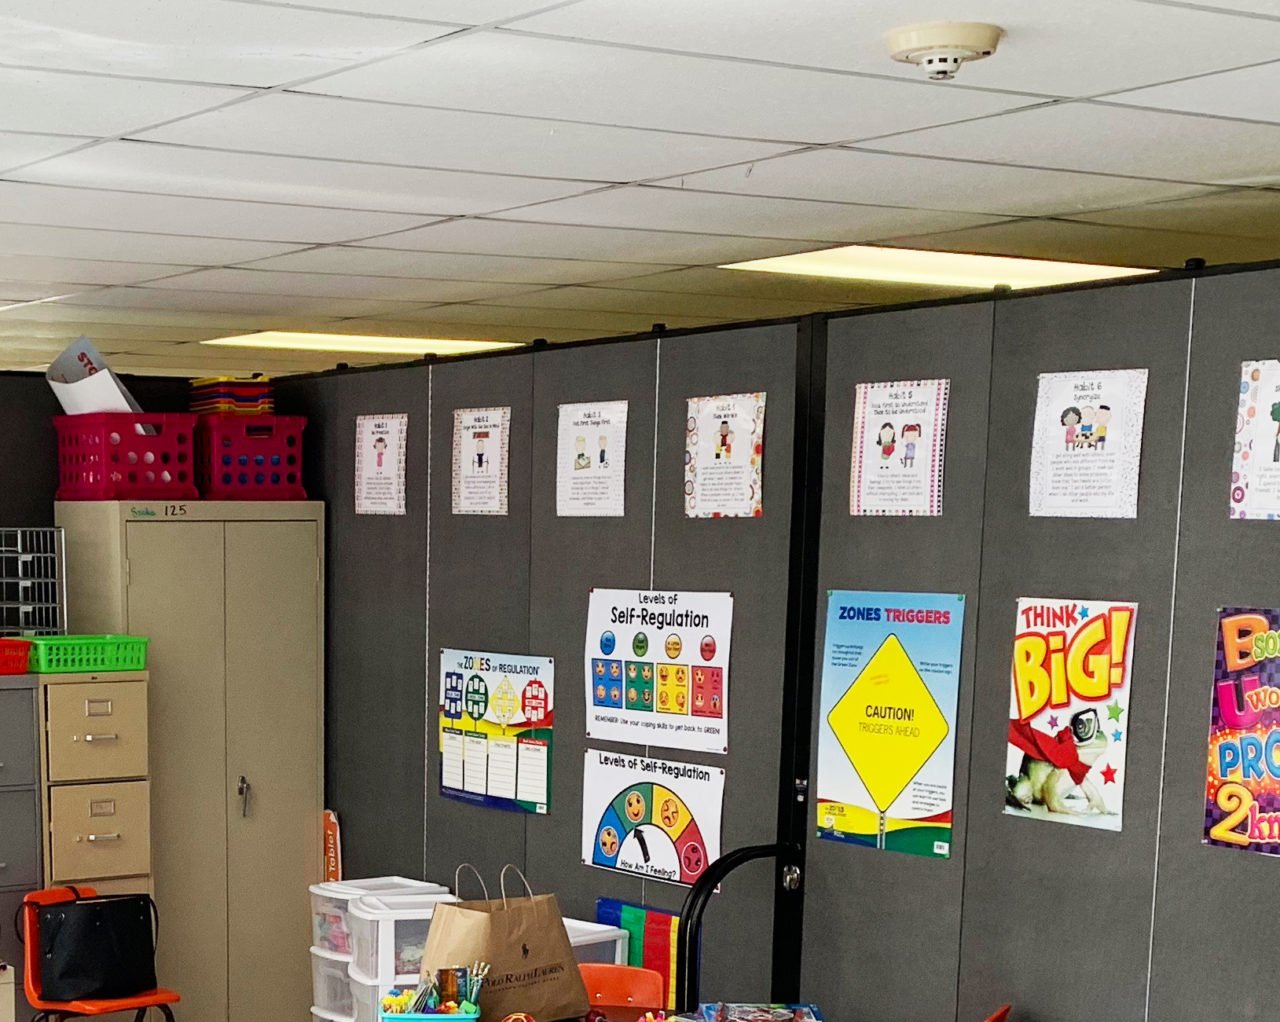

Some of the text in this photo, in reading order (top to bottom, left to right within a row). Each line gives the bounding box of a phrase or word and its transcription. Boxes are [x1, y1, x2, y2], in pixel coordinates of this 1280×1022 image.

[1097, 381, 1102, 390] 6
[165, 504, 187, 516] 125
[638, 592, 678, 604] Levels of
[610, 606, 709, 630] Self-Regulation
[839, 606, 951, 624] ZONES TRIGGERS
[1021, 603, 1079, 629] THINK
[1220, 613, 1269, 673] B
[463, 656, 491, 672] ZONES
[1217, 675, 1263, 729] U
[865, 704, 914, 721] CAUTION!
[859, 722, 920, 738] TRIGGERS AHEAD
[599, 752, 710, 781] Levels of Self-Regulation
[1209, 781, 1255, 846] 2
[620, 859, 677, 878] How Am I Feeling?
